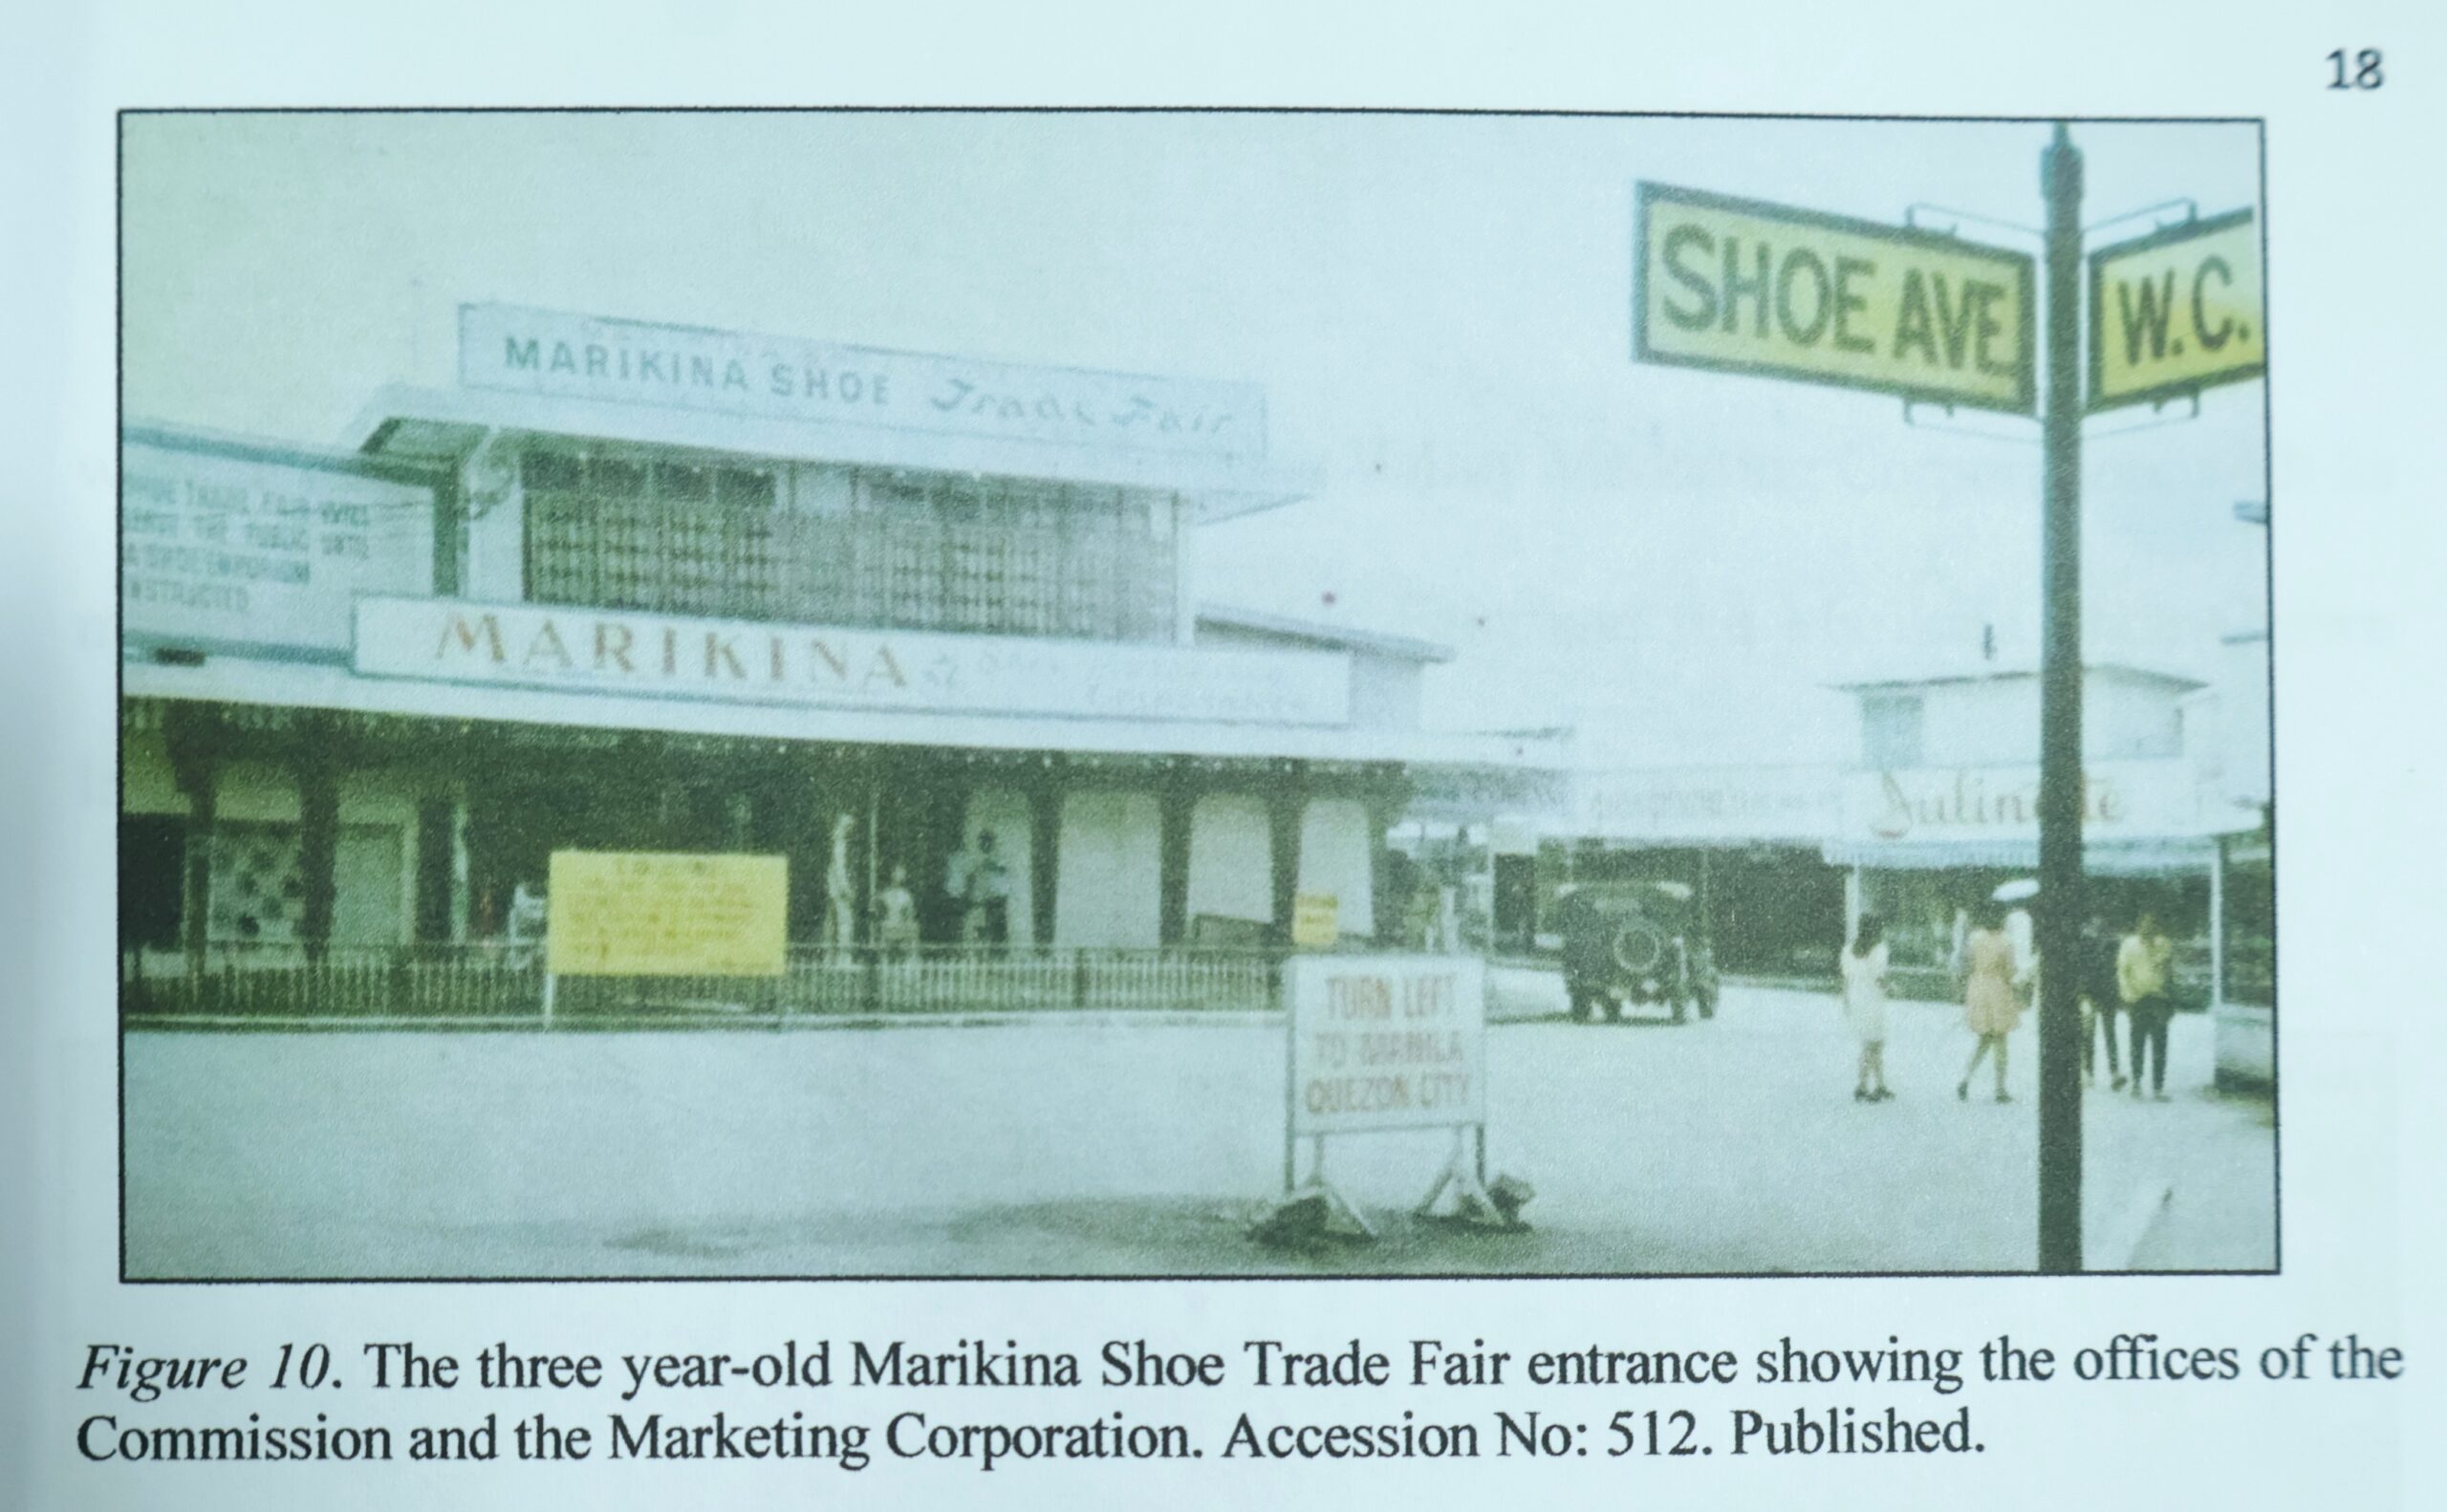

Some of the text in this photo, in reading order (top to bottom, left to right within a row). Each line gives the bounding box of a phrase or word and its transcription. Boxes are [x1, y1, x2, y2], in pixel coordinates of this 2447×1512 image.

[2326, 49, 2384, 90] 18
[1661, 223, 2005, 376] SHOE AVE
[2117, 254, 2250, 367] W.C.
[504, 335, 750, 391] MARIKINA
[770, 362, 890, 405] SHOE
[435, 612, 908, 688] MARIKINA
[1326, 972, 1457, 1020] TURN LEFT
[1305, 1071, 1473, 1115] QUEZON CITY
[76, 1334, 2403, 1402] Figure 10. The three year-old Marikina Shoe Trade Fair entrance showing the offices of the
[76, 1407, 1985, 1471] Commission and the Marketing Corporation. Accession No: 512. Published.
